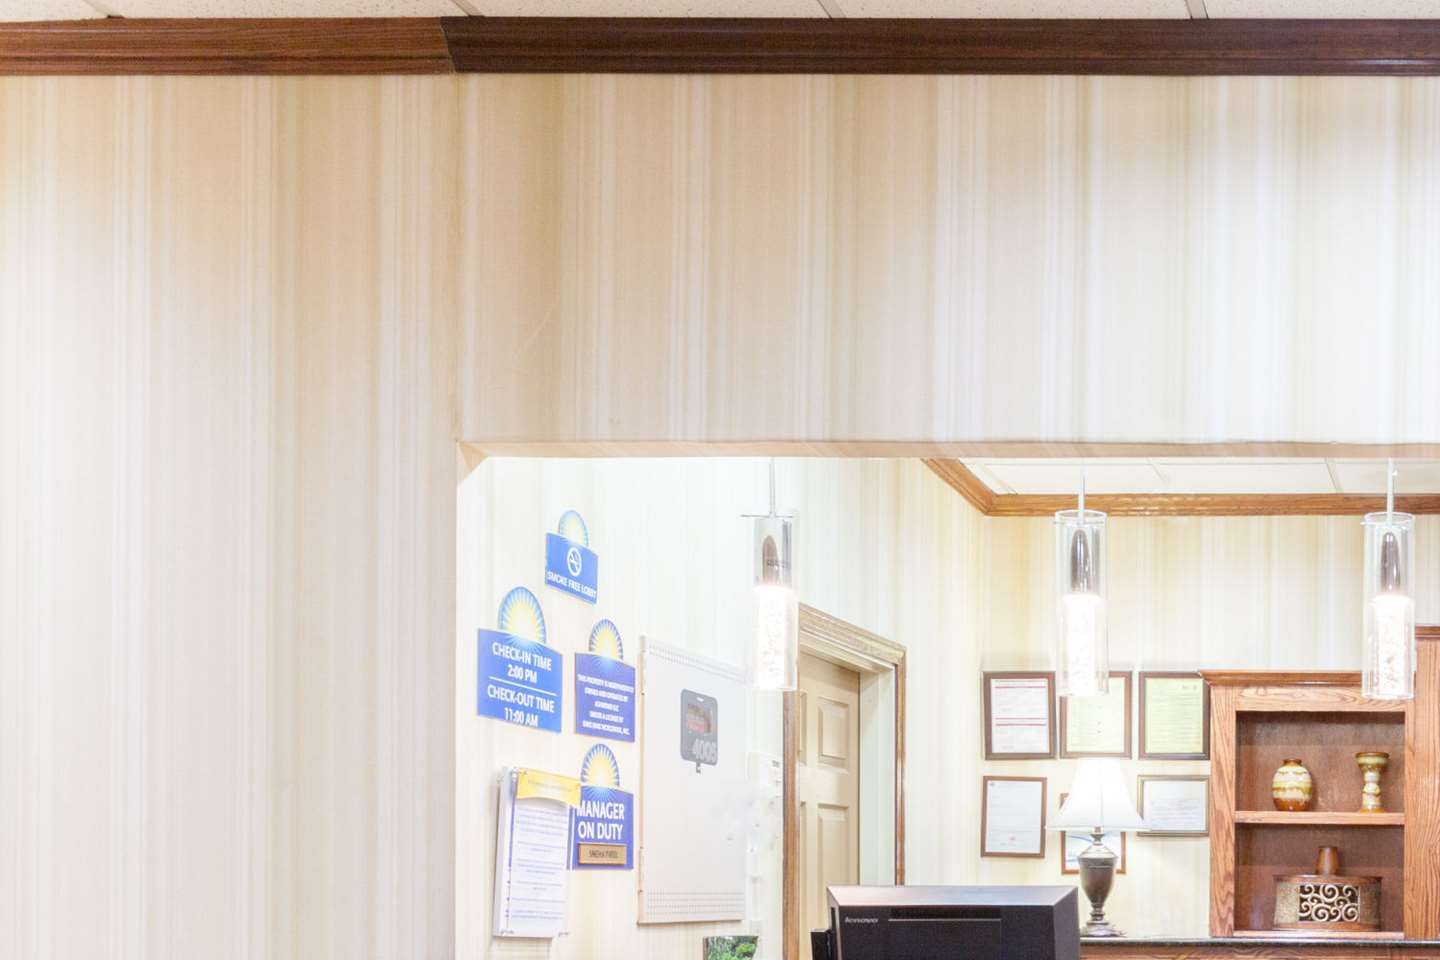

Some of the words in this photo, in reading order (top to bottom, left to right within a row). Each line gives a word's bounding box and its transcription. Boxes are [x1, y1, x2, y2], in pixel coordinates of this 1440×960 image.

[547, 571, 568, 586] SMOKE
[569, 578, 582, 592] FREE
[492, 641, 532, 665] CHECK-IN
[532, 653, 553, 671] TIME
[507, 663, 524, 681] 2:00
[524, 668, 538, 684] PM
[487, 684, 536, 708] CHECK-OUT
[536, 696, 555, 713] TIME
[504, 707, 524, 725] 11:00
[525, 712, 538, 727] AM
[577, 800, 625, 820] MANAGER
[578, 821, 595, 839] ON
[597, 822, 623, 841] DUTY
